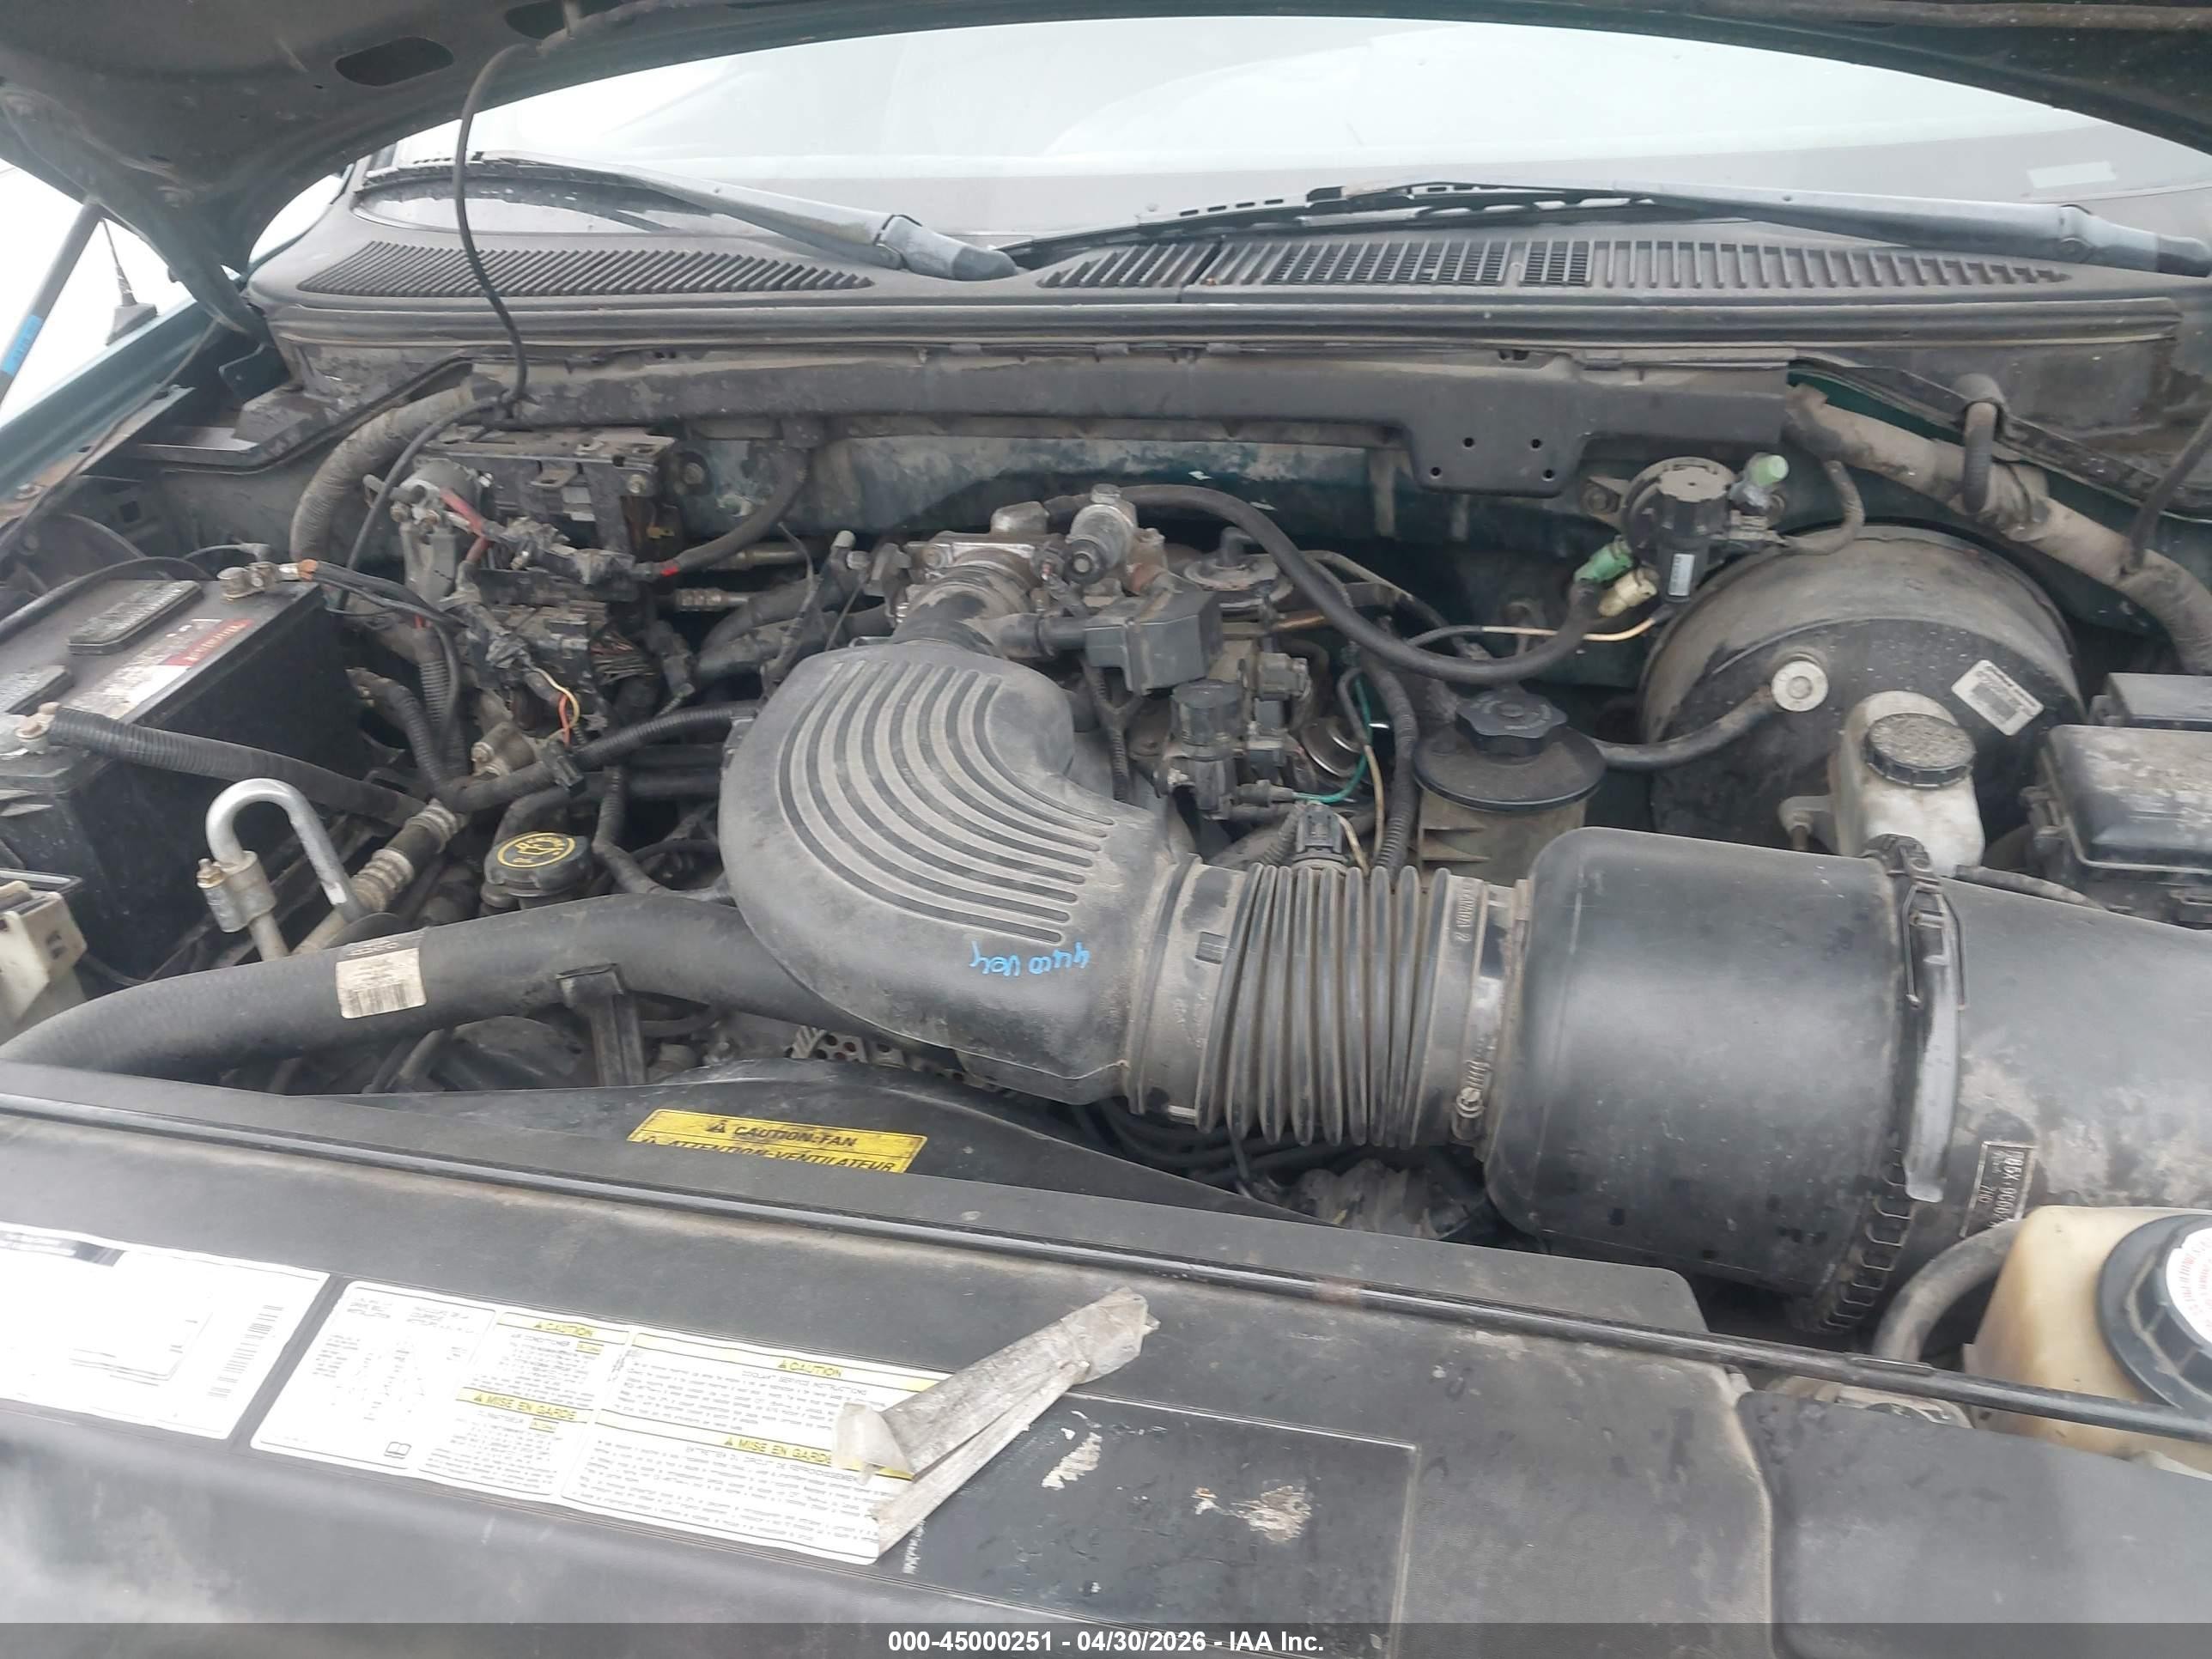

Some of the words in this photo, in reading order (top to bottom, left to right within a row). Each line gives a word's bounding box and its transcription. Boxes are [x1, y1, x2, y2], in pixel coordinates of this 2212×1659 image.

[789, 1361, 842, 1377] CAUTION
[738, 1438, 769, 1452] MISE
[771, 1444, 787, 1456] EN
